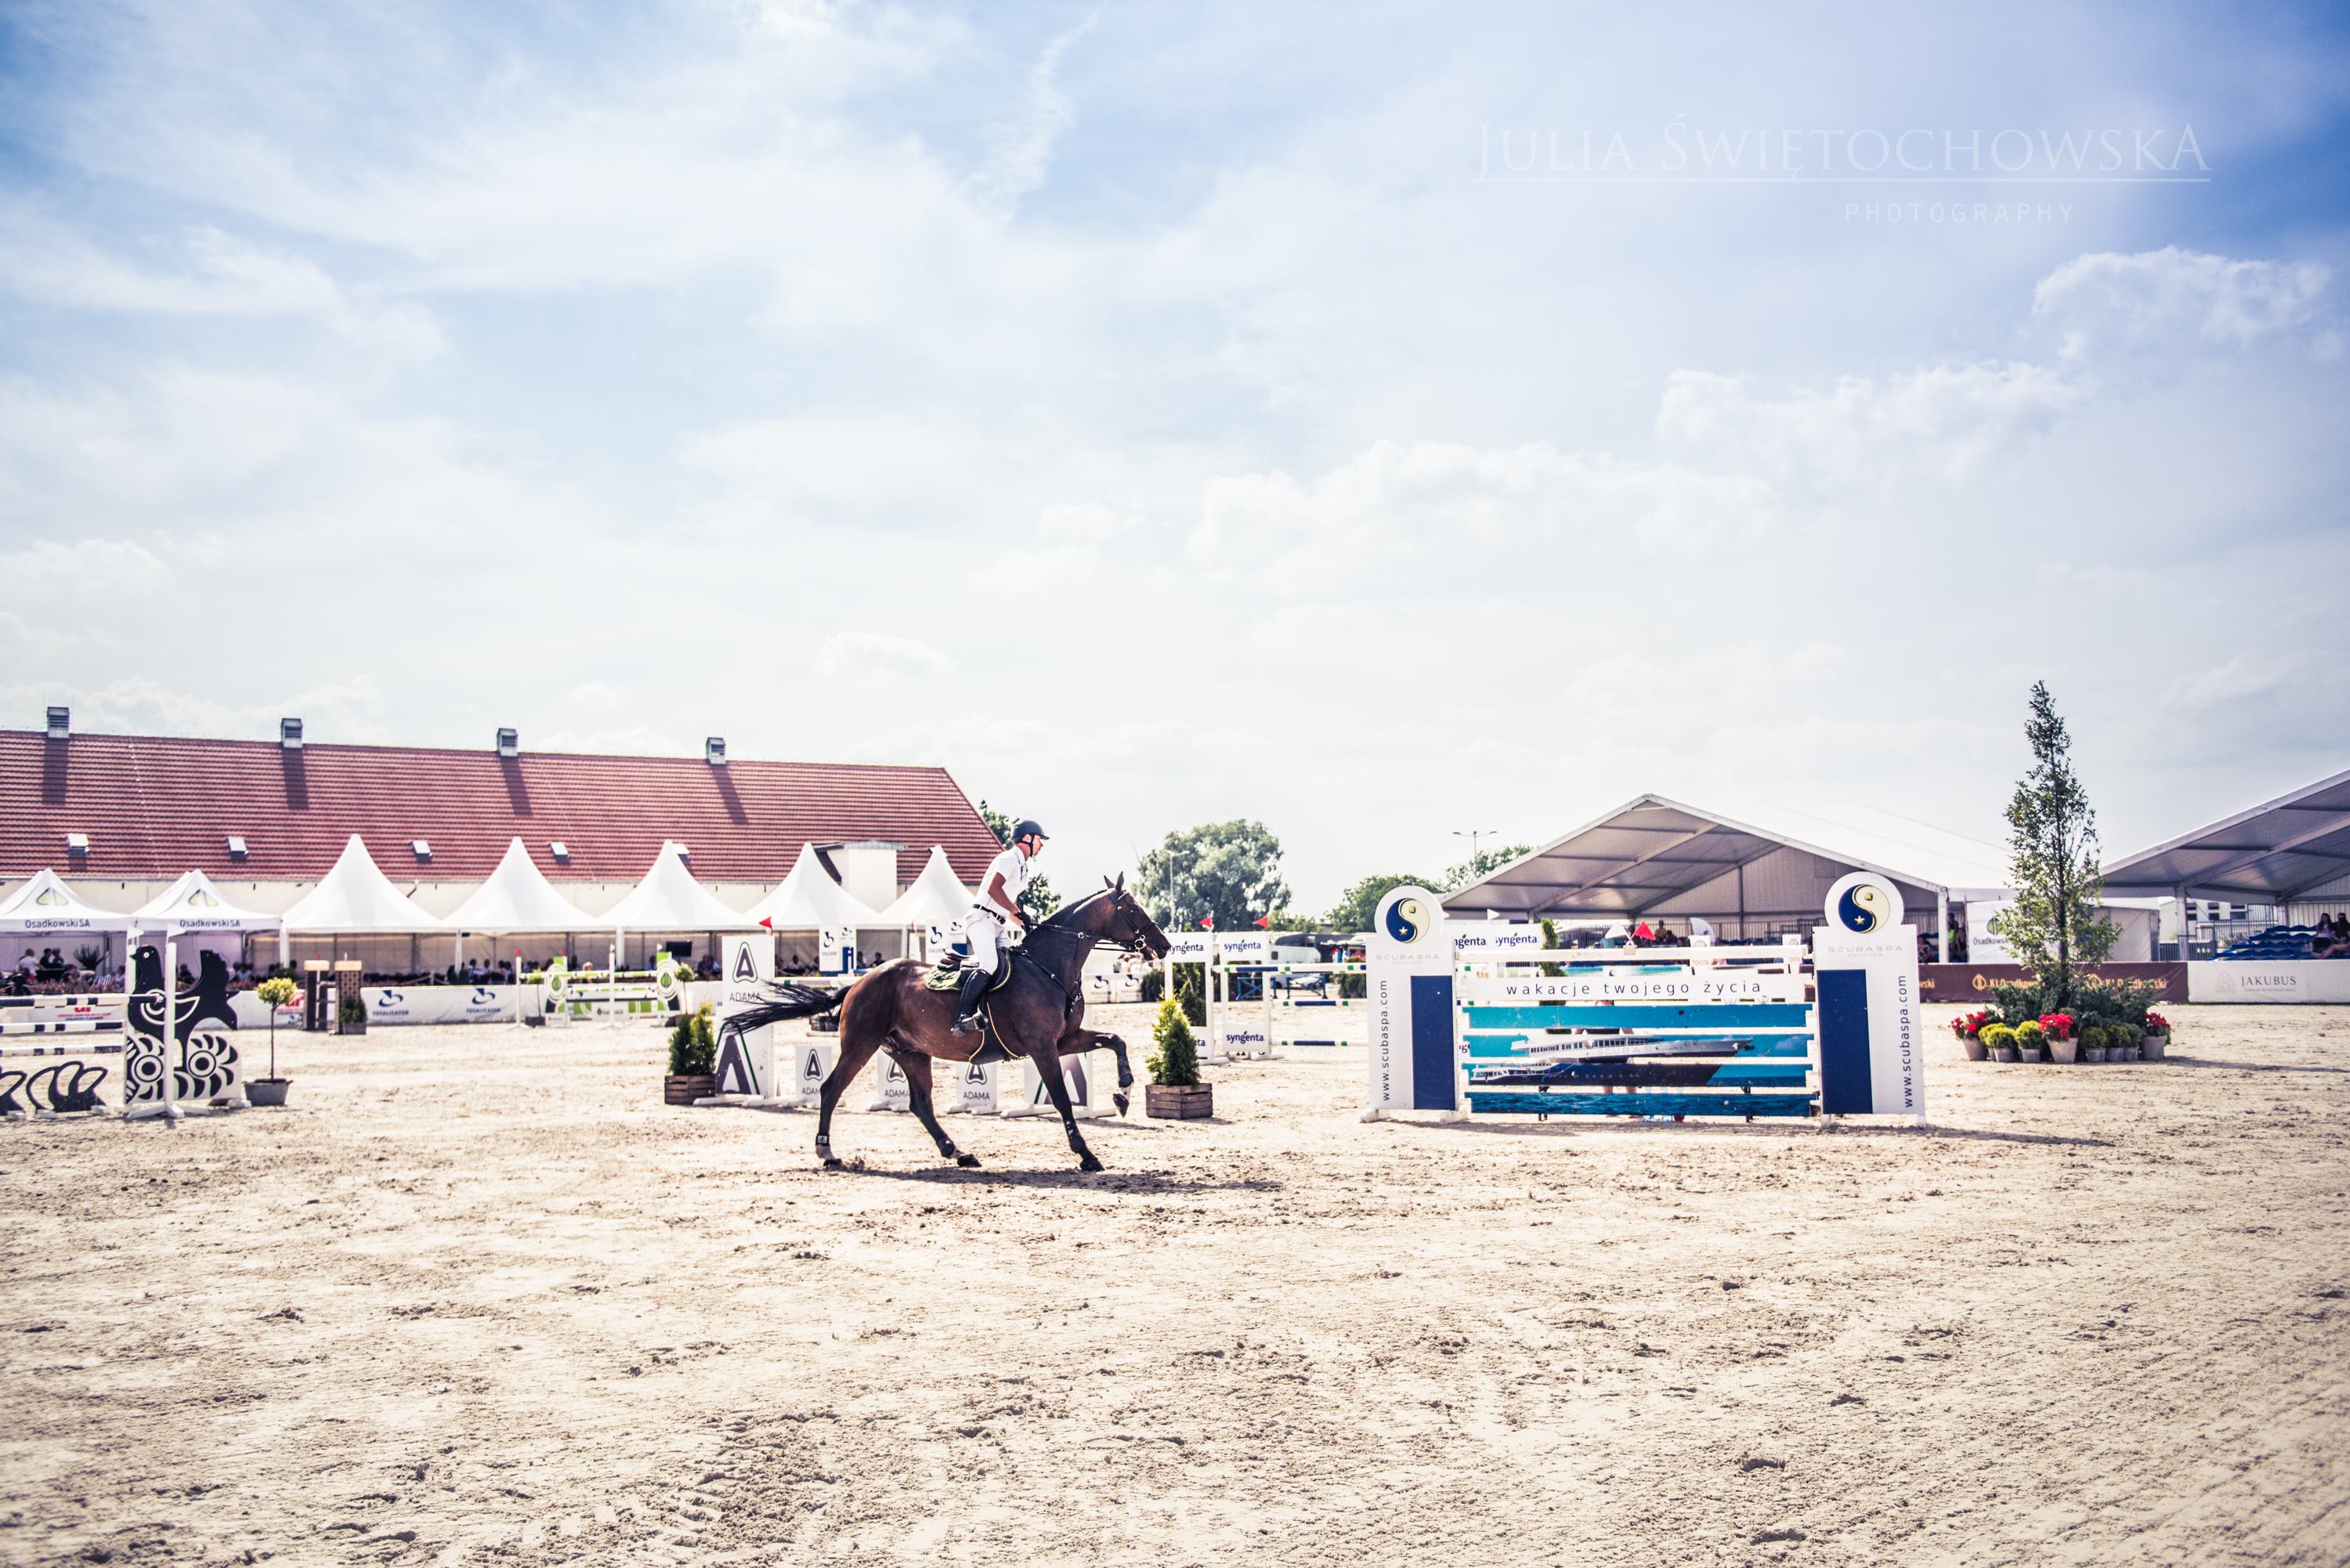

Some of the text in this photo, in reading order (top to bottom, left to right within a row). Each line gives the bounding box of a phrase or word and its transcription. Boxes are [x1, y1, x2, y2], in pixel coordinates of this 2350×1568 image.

[1224, 941, 1261, 952] syngenta
[1455, 937, 1486, 949] ngenta
[2241, 976, 2297, 988] JAKUBUS
[1506, 980, 1761, 997] wakacje twojego życia
[729, 992, 761, 1003] ADAMA
[1226, 1032, 1264, 1044] syngenta
[1379, 980, 1390, 1101] www.scubaspa.com
[1898, 975, 1913, 1107] www.scubaspa.com
[801, 1086, 822, 1096] ADAM
[963, 1091, 991, 1100] ADAMA
